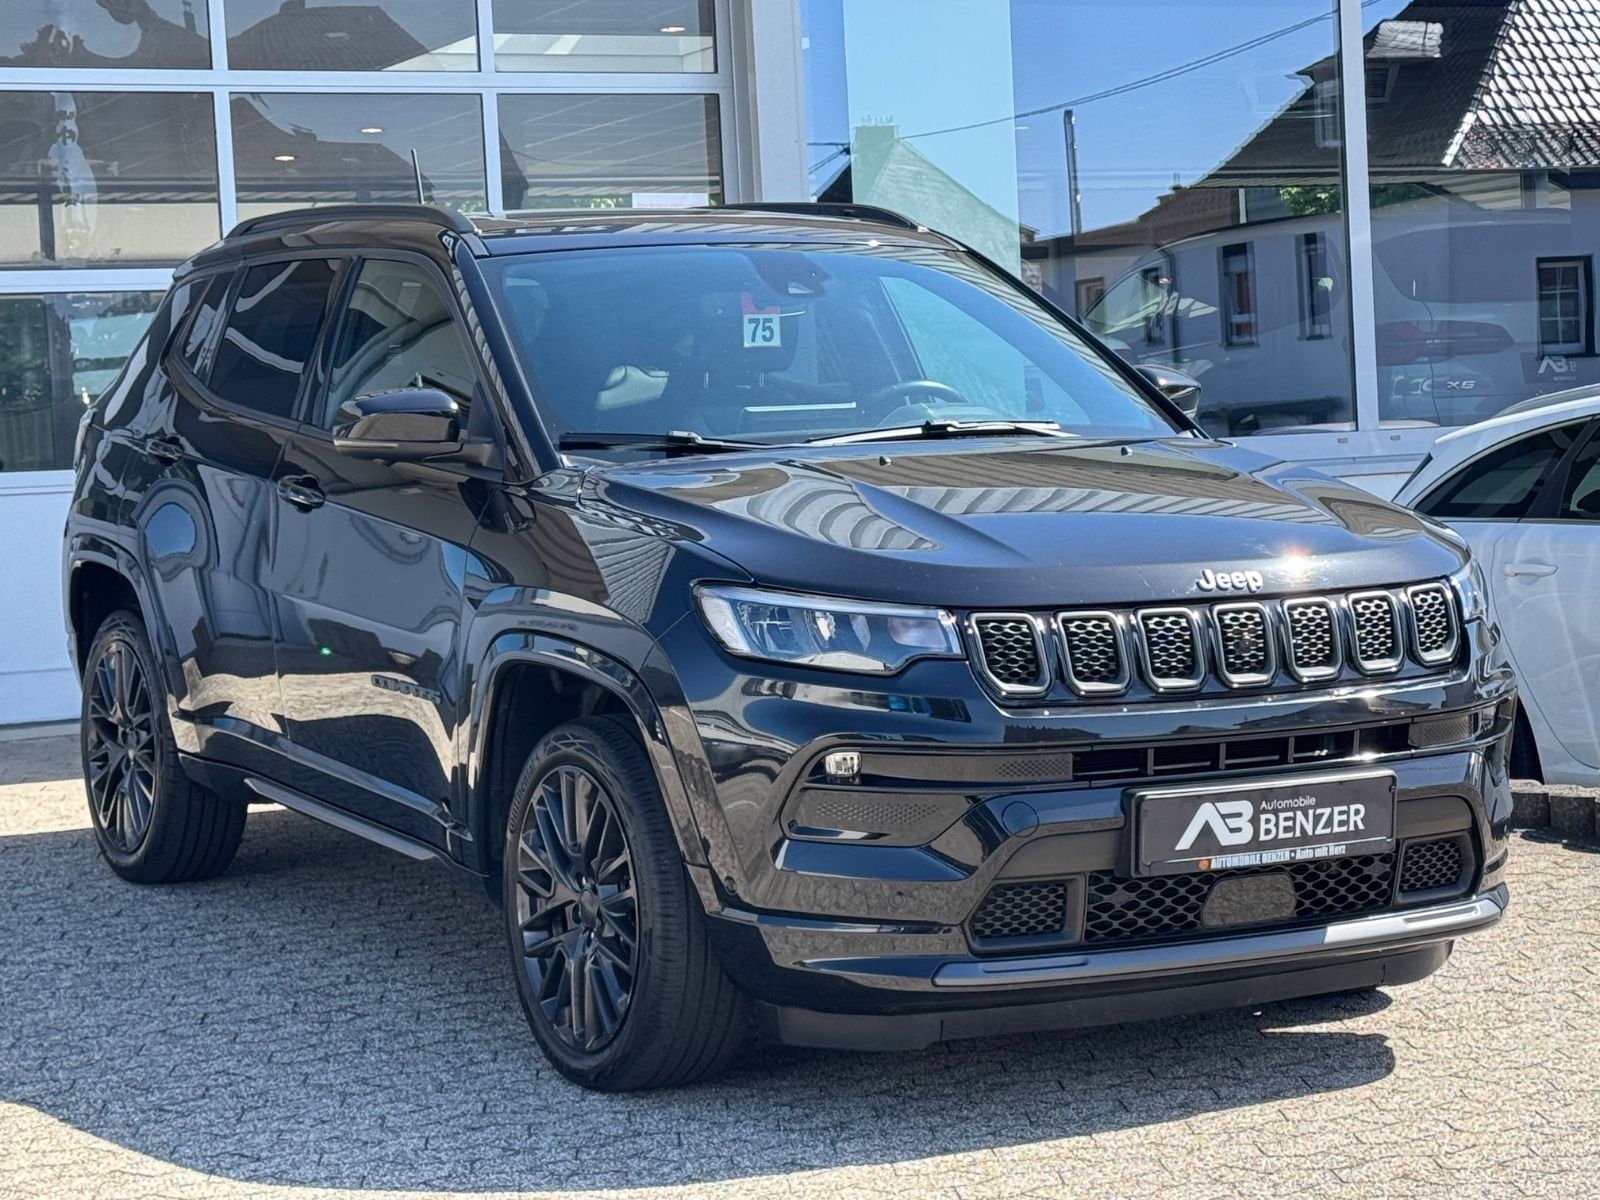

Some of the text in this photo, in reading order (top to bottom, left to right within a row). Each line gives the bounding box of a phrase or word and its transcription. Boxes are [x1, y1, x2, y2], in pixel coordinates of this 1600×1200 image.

[748, 317, 775, 343] 75
[1196, 568, 1263, 593] Jeep
[1260, 795, 1316, 811] Automobile
[1174, 800, 1254, 851] AB
[1259, 803, 1366, 842] BENZER
[1210, 853, 1262, 869] AUTOMOBILE
[1262, 850, 1291, 865] BENZER
